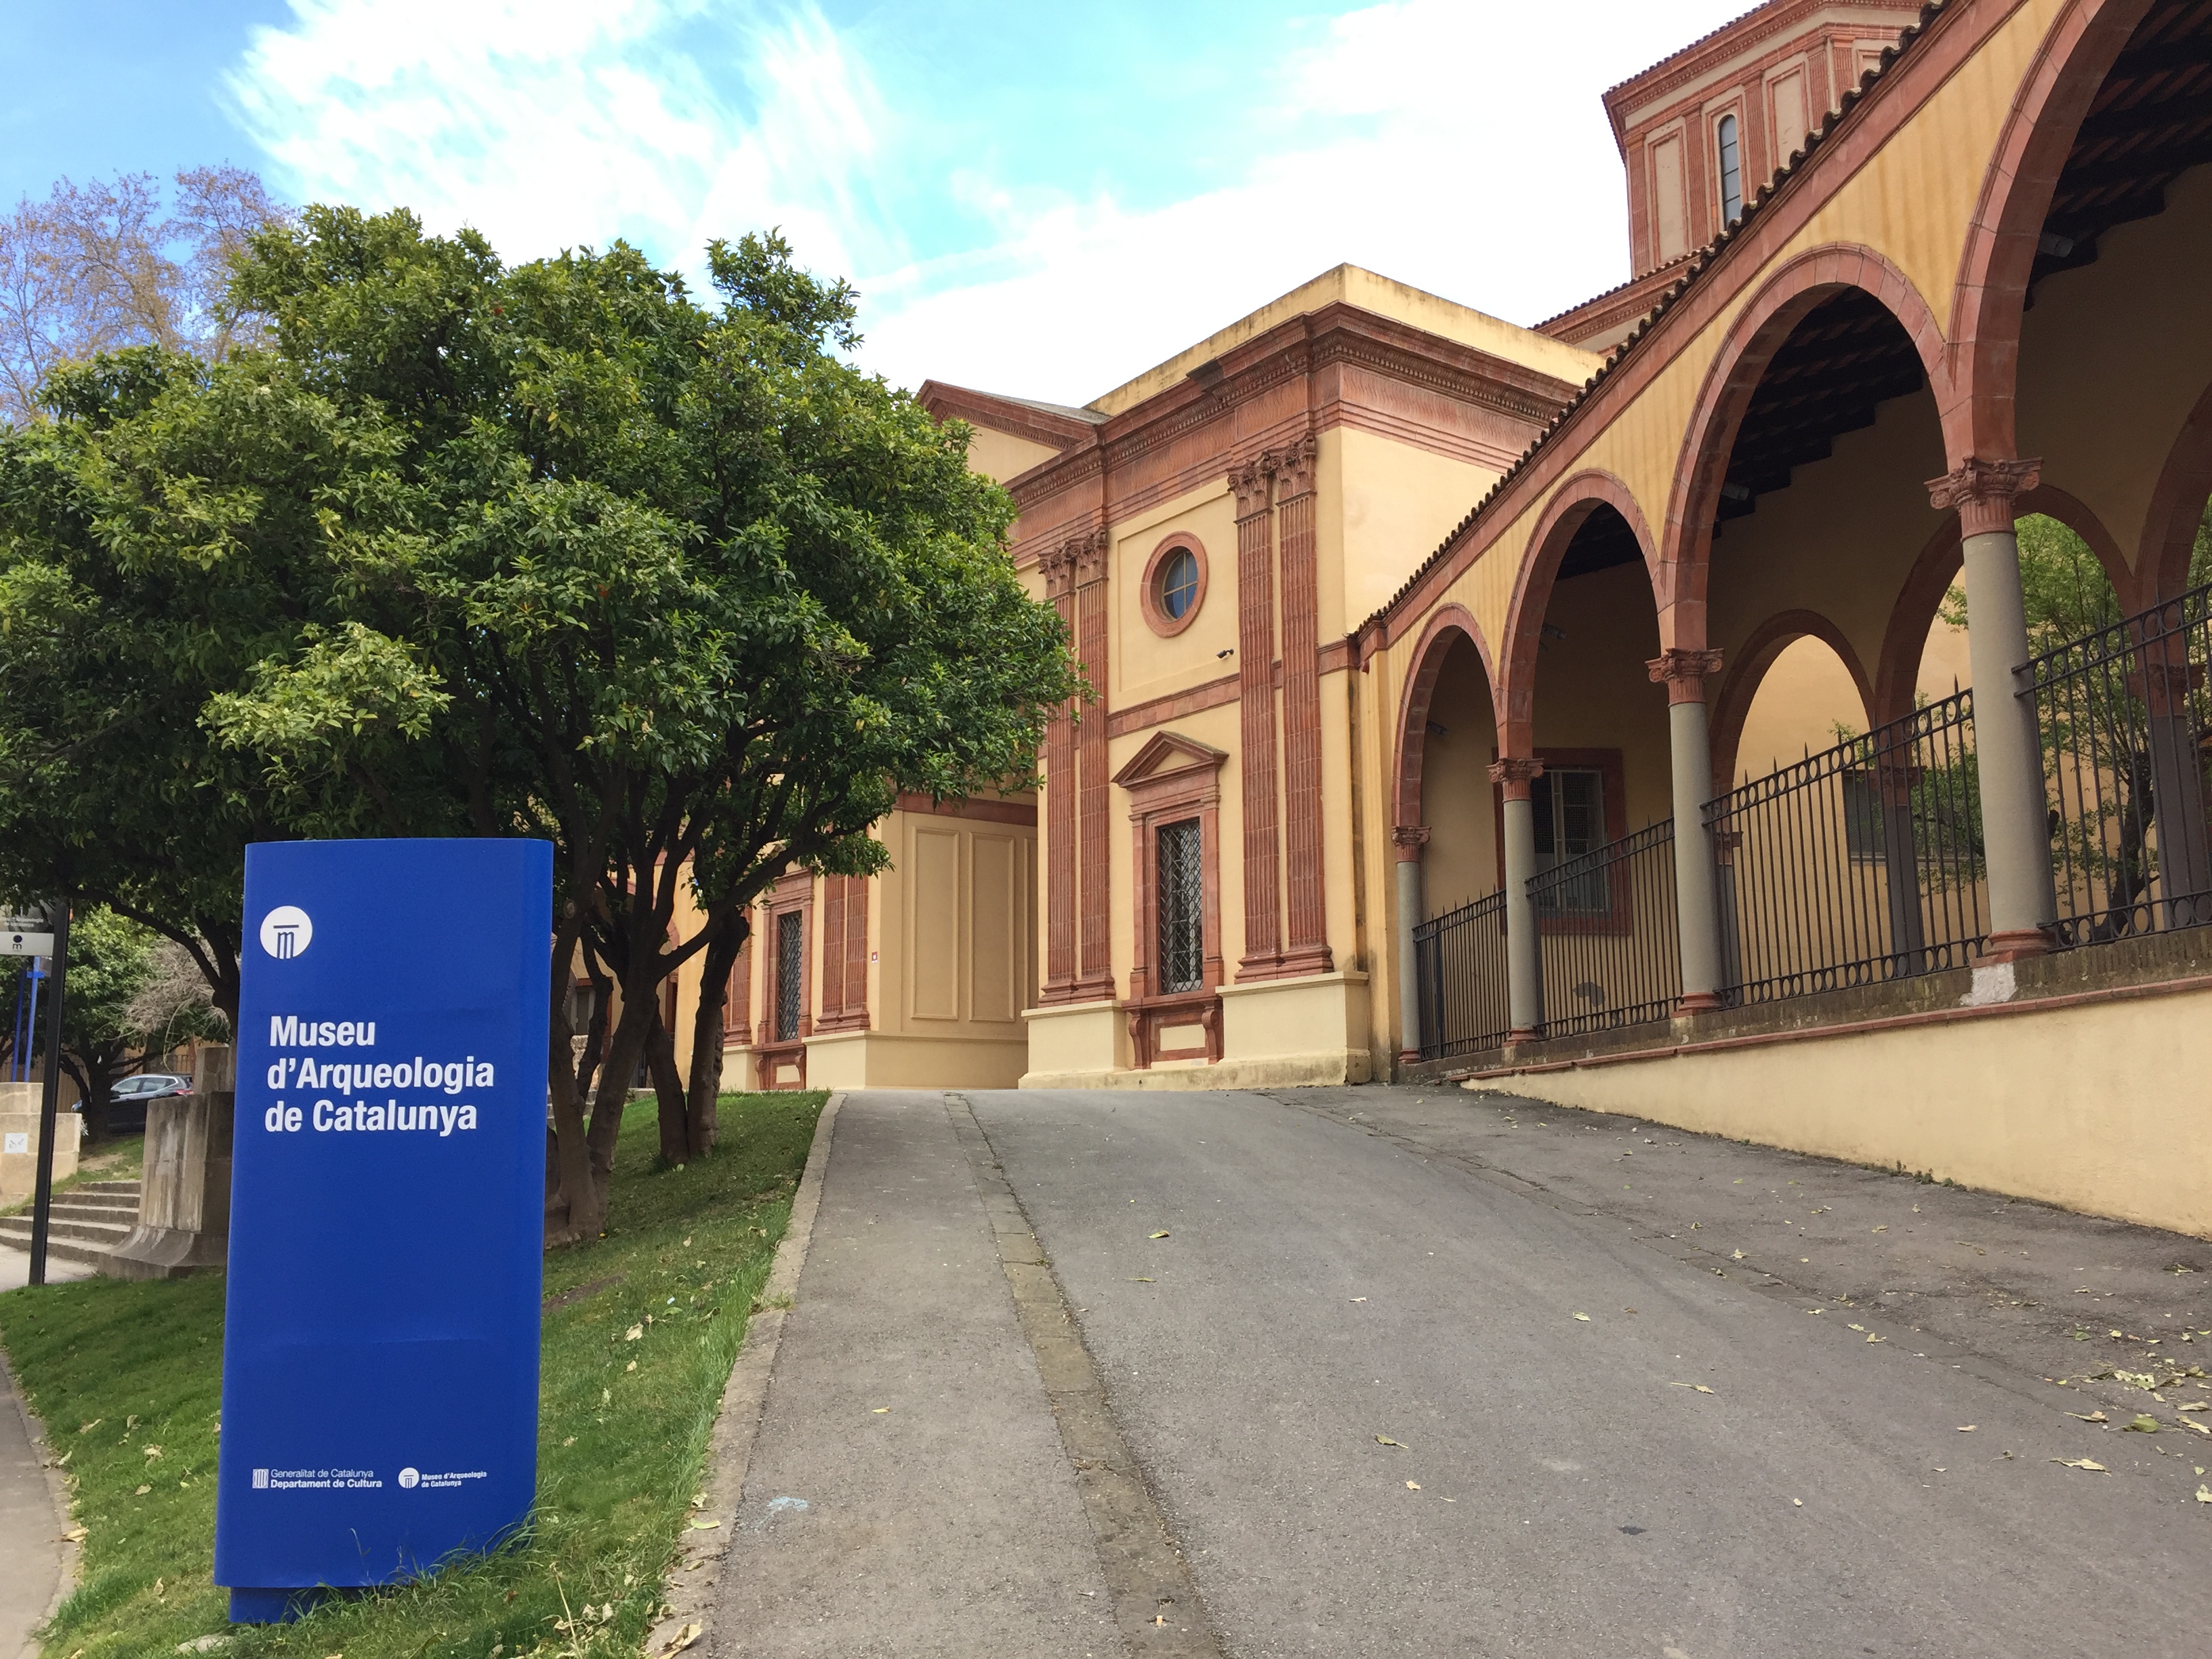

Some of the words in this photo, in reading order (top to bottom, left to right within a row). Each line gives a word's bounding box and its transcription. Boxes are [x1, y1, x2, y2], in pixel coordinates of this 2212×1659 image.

[270, 1015, 375, 1046] Museu
[267, 1056, 494, 1095] d'Arqueologia
[264, 1101, 302, 1132] de
[312, 1099, 477, 1137] Catalunya
[270, 1480, 331, 1490] Departament
[333, 1479, 345, 1488] de
[347, 1479, 382, 1488] Cultura
[271, 1469, 315, 1478] Generalitat
[317, 1469, 329, 1478] de
[331, 1469, 373, 1479] Catalunya
